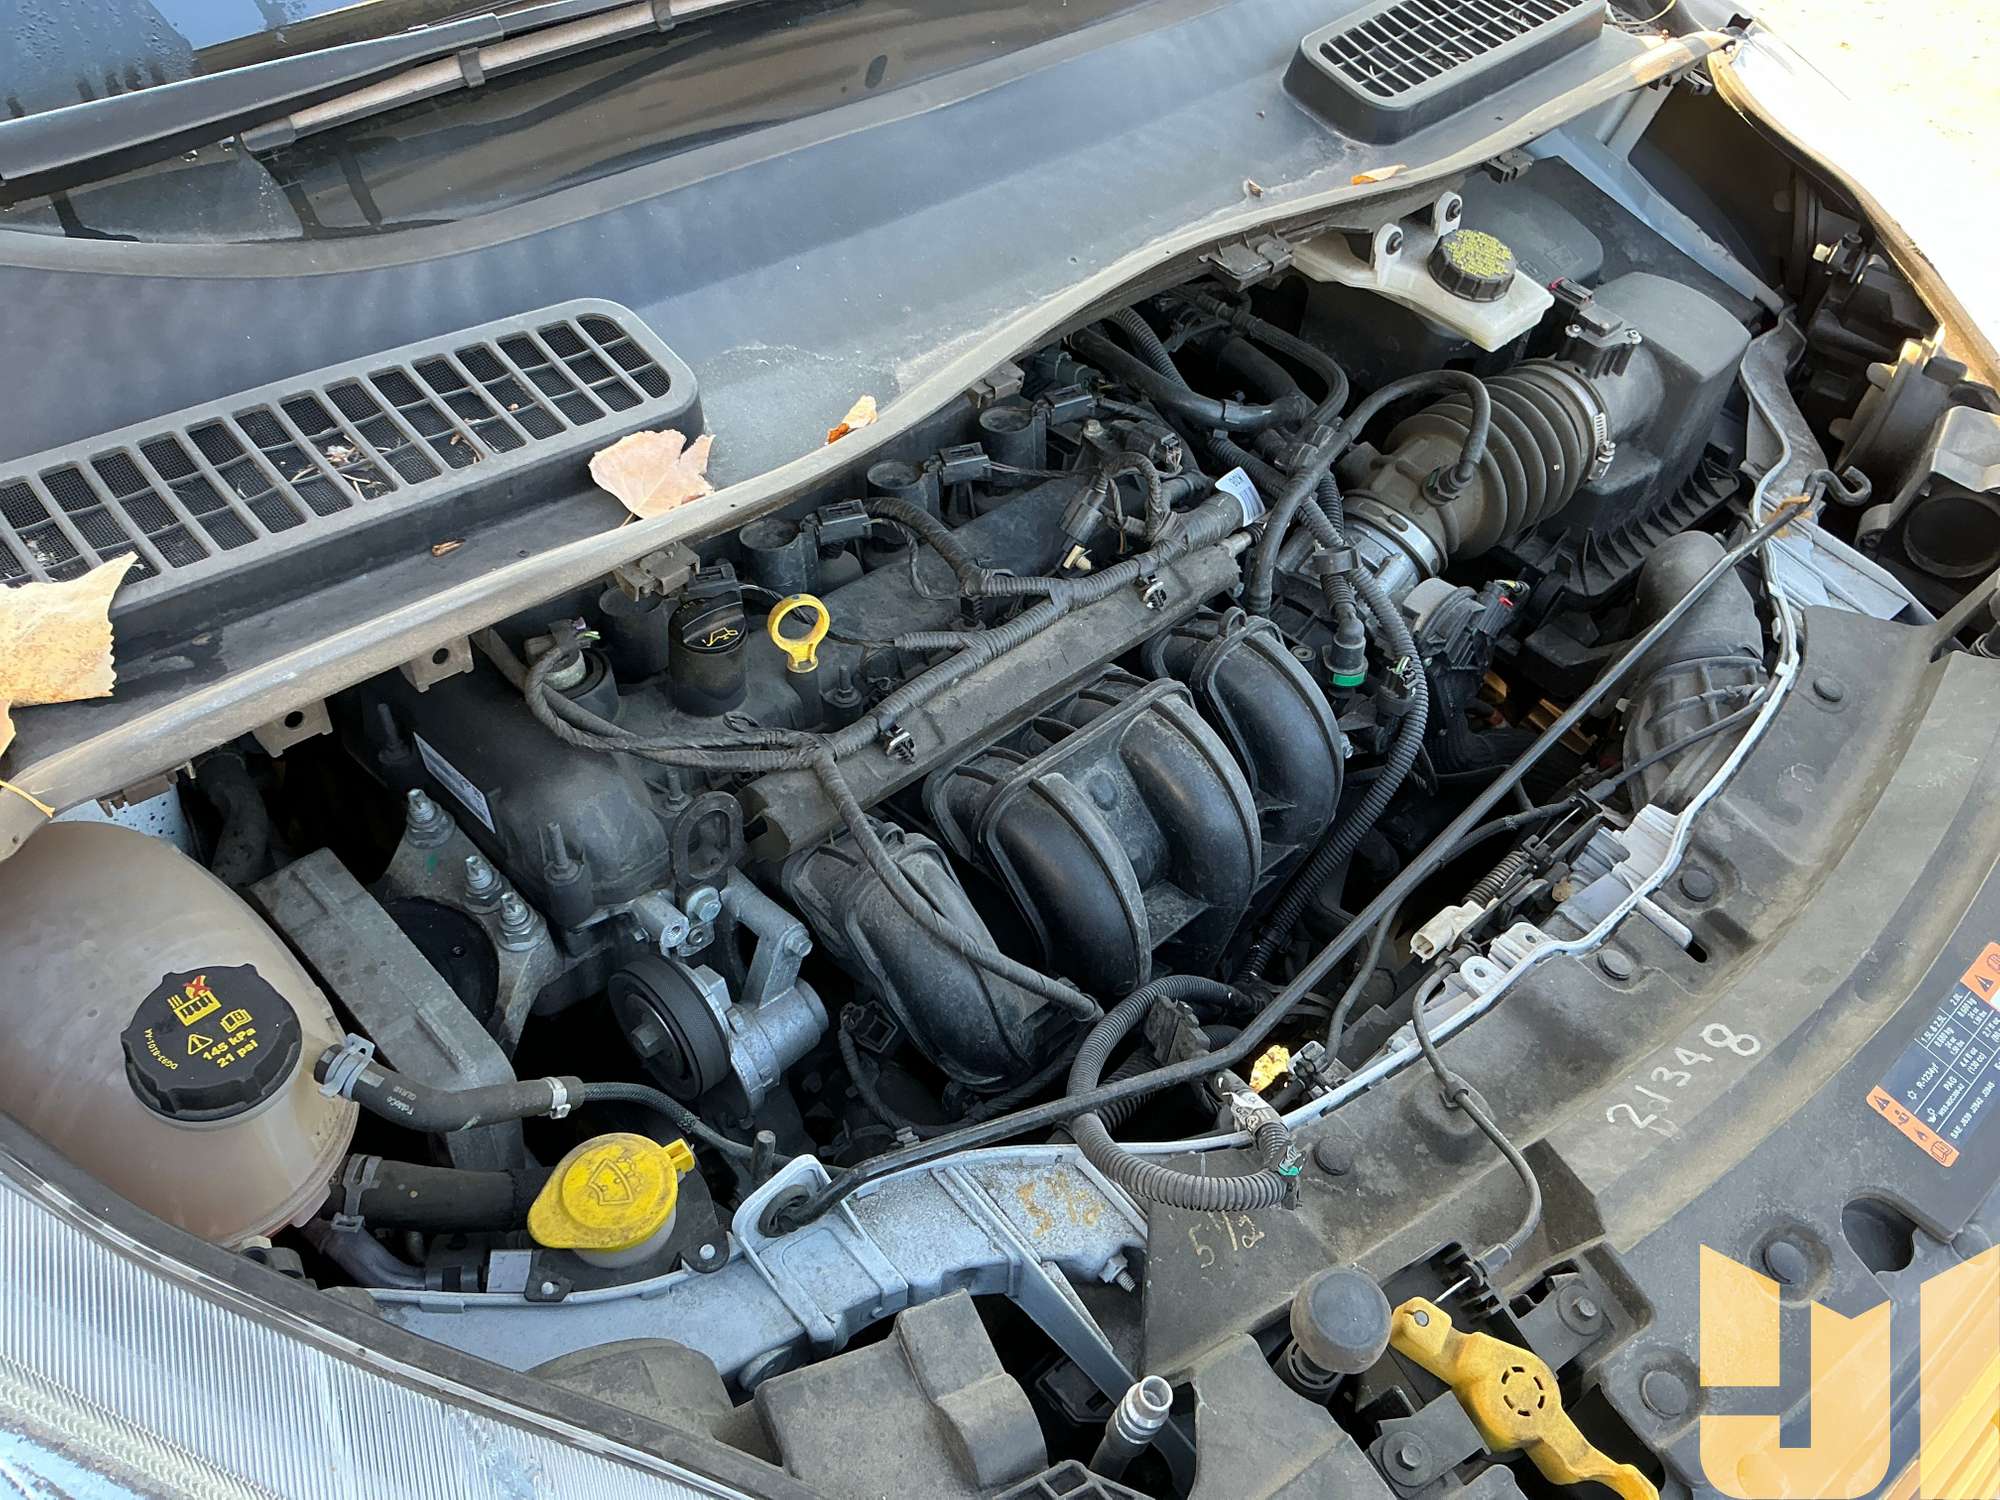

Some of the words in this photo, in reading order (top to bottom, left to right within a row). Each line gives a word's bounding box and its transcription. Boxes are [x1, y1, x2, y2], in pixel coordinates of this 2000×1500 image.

[203, 1042, 229, 1060] 145
[229, 1028, 256, 1046] kPa
[217, 1053, 236, 1068] 21
[237, 1039, 258, 1057] psi
[1916, 1062, 1939, 1089] R-1234yf
[1943, 1076, 1957, 1091] PAG
